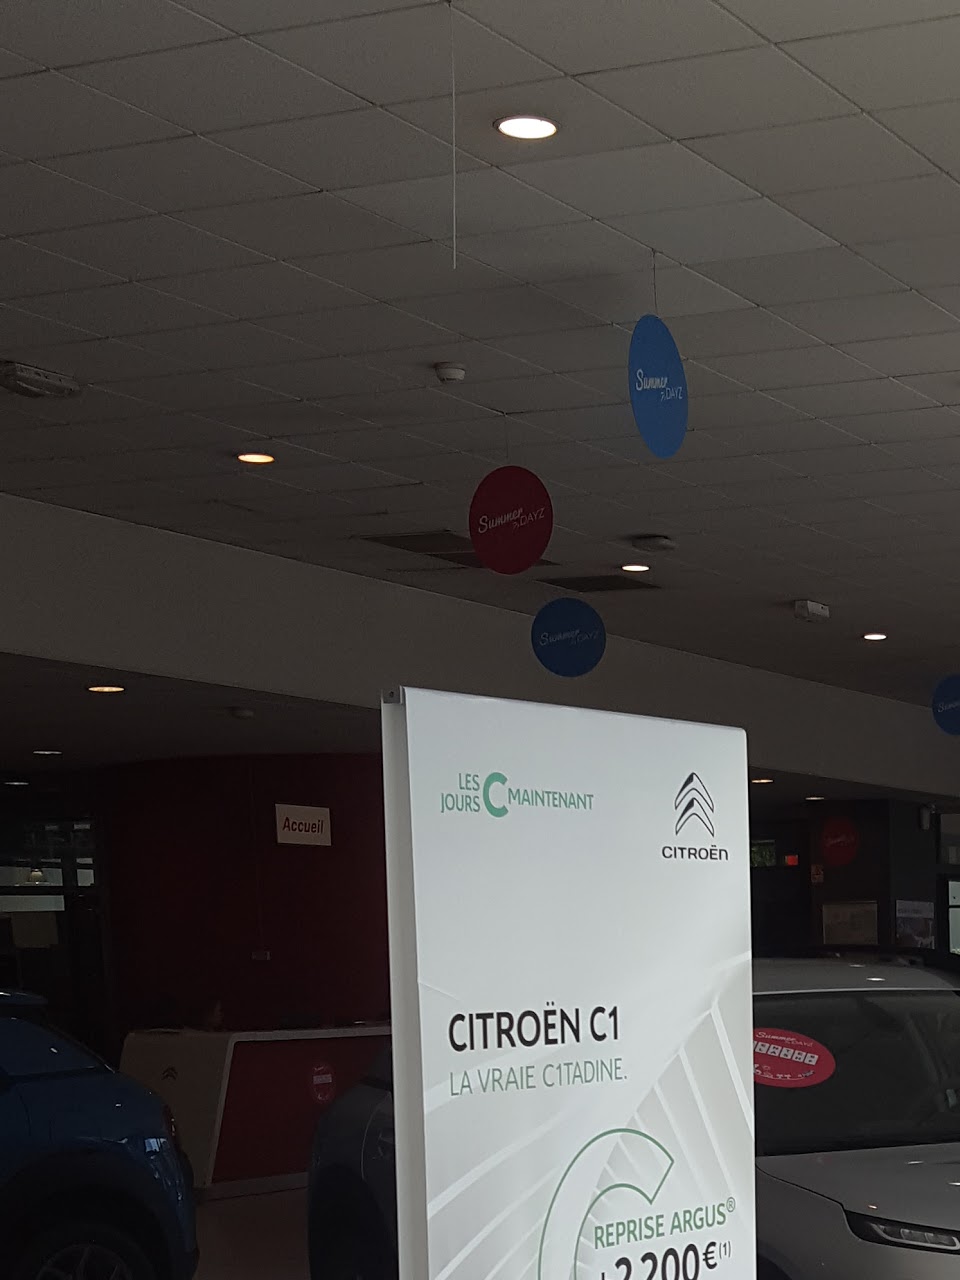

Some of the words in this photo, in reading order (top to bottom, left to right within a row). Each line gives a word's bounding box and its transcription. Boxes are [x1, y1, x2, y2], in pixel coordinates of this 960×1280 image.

[635, 368, 668, 391] Summer
[665, 386, 683, 400] DAYZ
[478, 507, 524, 534] Summer
[520, 506, 546, 527] DAYZ
[458, 773, 480, 791] LES
[440, 792, 480, 813] JOURS
[482, 772, 509, 818] C
[507, 787, 594, 810] MAINTENANT
[282, 816, 324, 834] Accueil
[661, 844, 729, 861] CITROËN
[448, 1001, 581, 1052] CITROËN
[590, 1005, 618, 1042] C1
[450, 1070, 473, 1096] LA
[477, 1065, 536, 1093] VRAIE
[594, 1214, 665, 1249] REPRISE
